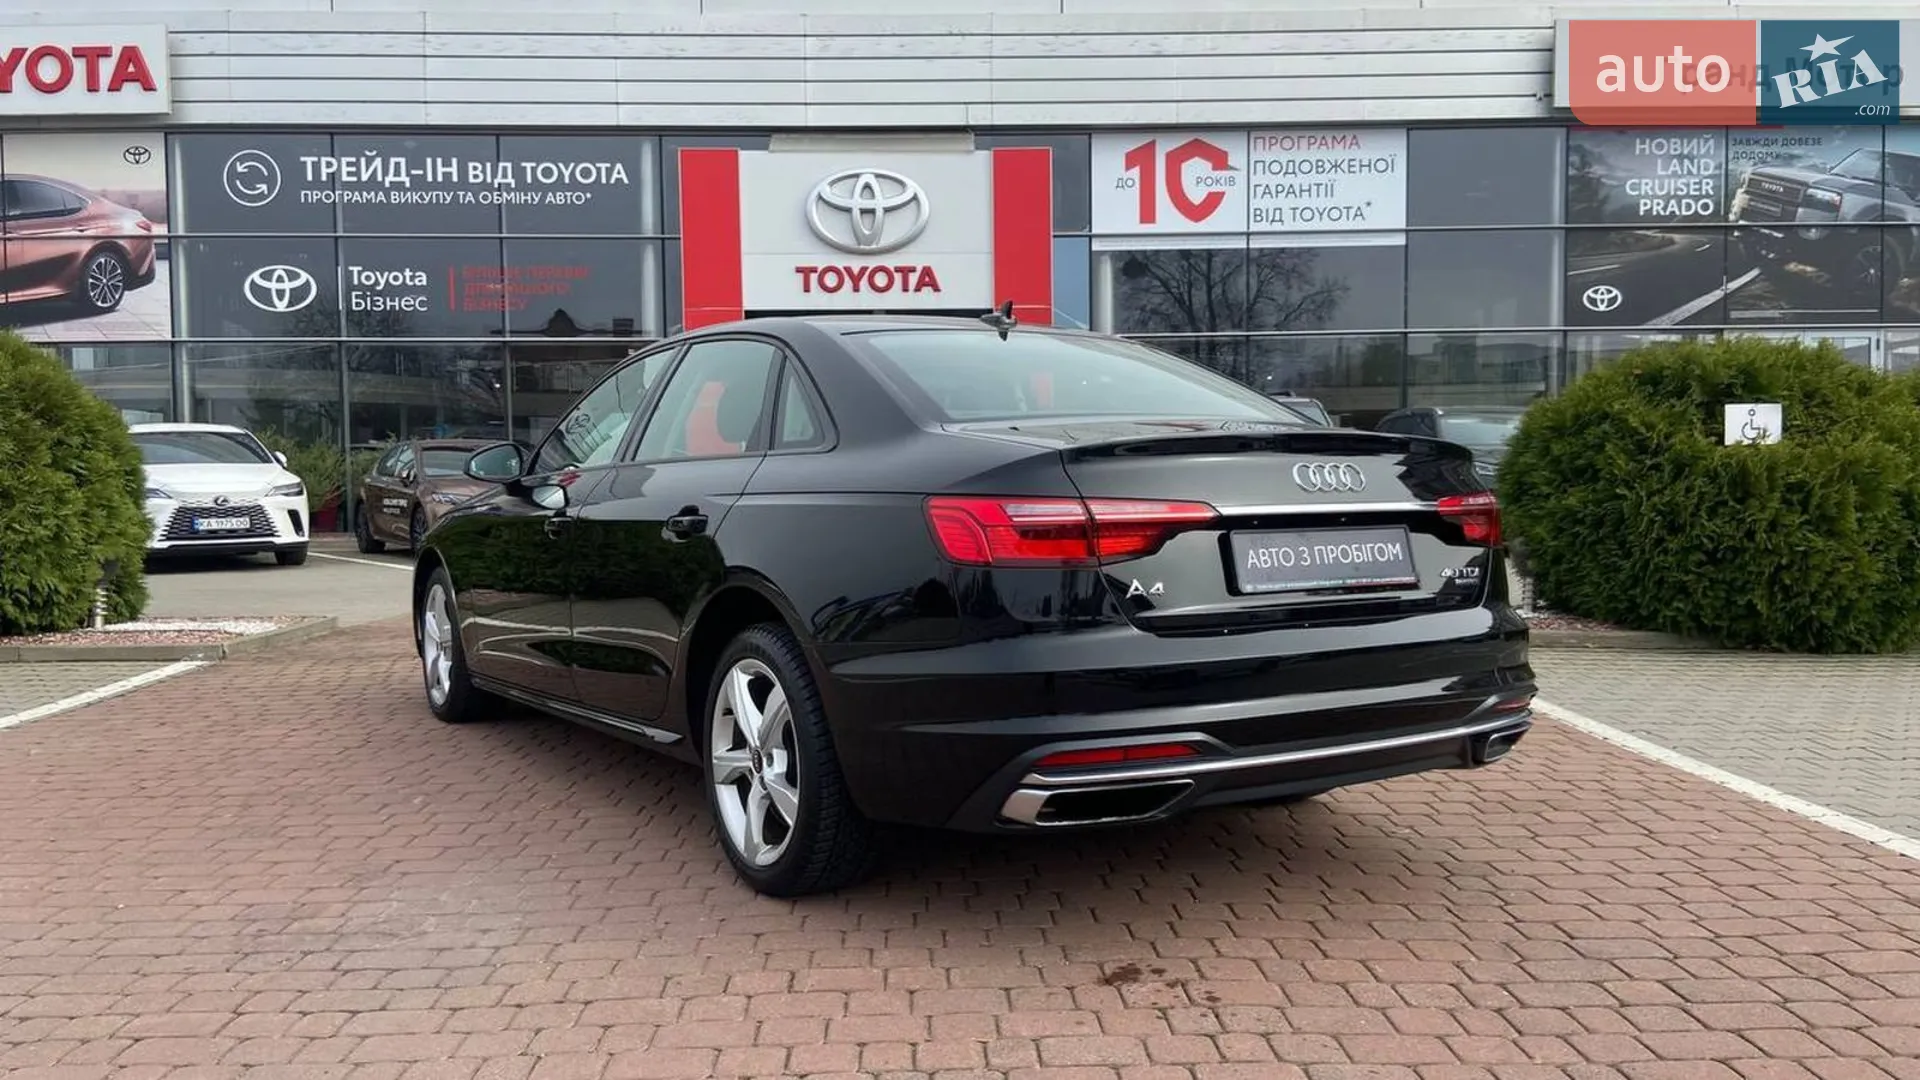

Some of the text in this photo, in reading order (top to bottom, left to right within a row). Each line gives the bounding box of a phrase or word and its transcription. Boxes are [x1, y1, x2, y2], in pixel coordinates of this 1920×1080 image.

[1253, 134, 1361, 151] ПРОГРАМА
[1635, 133, 1715, 156] НОВИЙ
[1732, 136, 1824, 148] ЗАВЖДИ ДОВЕЗЕ
[299, 150, 629, 188] ТРЕЙД-ІН ВІД TOYOTA
[1253, 153, 1398, 177] ПОДОВЖЕНОЇ
[1656, 158, 1715, 175] LAND
[1115, 177, 1136, 190] ДО
[1195, 175, 1237, 187] РОКІВ
[1253, 179, 1336, 199] ГАРАНТІЇ
[1625, 178, 1715, 196] CRUISER
[300, 190, 387, 204] ПРОГРАМА
[390, 191, 454, 204] ВИКУПУ
[456, 191, 476, 205] ТА
[478, 191, 542, 205] ОБМІНУ
[1639, 198, 1715, 216] PRADO
[1253, 207, 1284, 225] ВІД
[347, 265, 428, 291] Toyota
[795, 265, 941, 294] TOYOTA
[351, 291, 429, 312] Бізнес
[1247, 542, 1403, 569] АВТО З ПРОБІГОМ
[1125, 578, 1165, 599] A4
